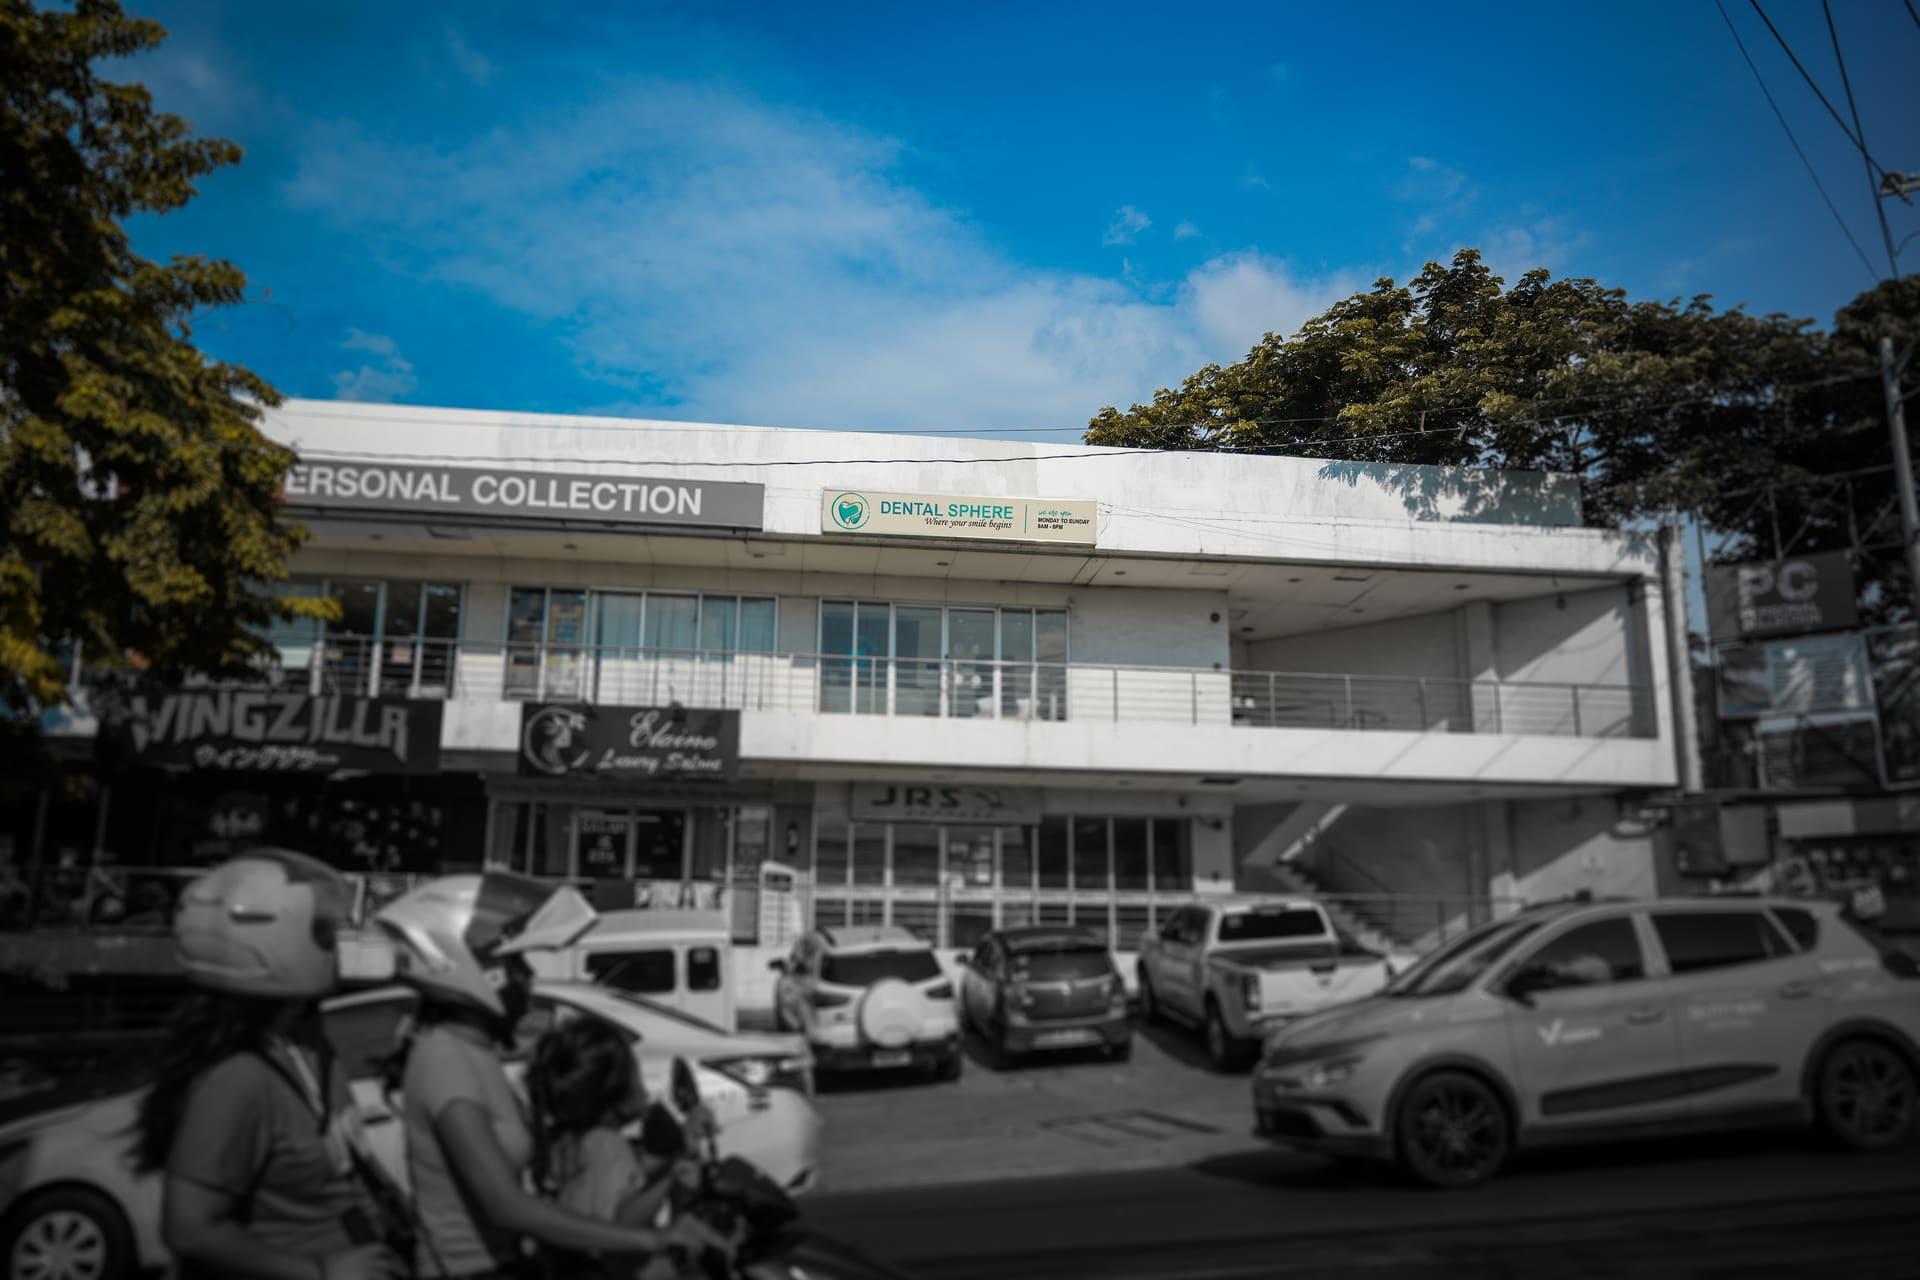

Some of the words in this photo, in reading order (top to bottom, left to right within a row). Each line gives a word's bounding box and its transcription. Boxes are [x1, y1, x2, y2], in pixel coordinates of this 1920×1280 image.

[284, 464, 460, 502] ERSONAL
[471, 474, 702, 515] COLLECTION
[880, 501, 943, 517] DENTAL
[947, 503, 1014, 520] SPHERE
[924, 516, 949, 526] Where
[949, 518, 967, 529] your
[967, 518, 988, 529] smile
[988, 519, 1013, 531] begins
[1737, 561, 1819, 602] PC
[871, 784, 961, 808] JRS
